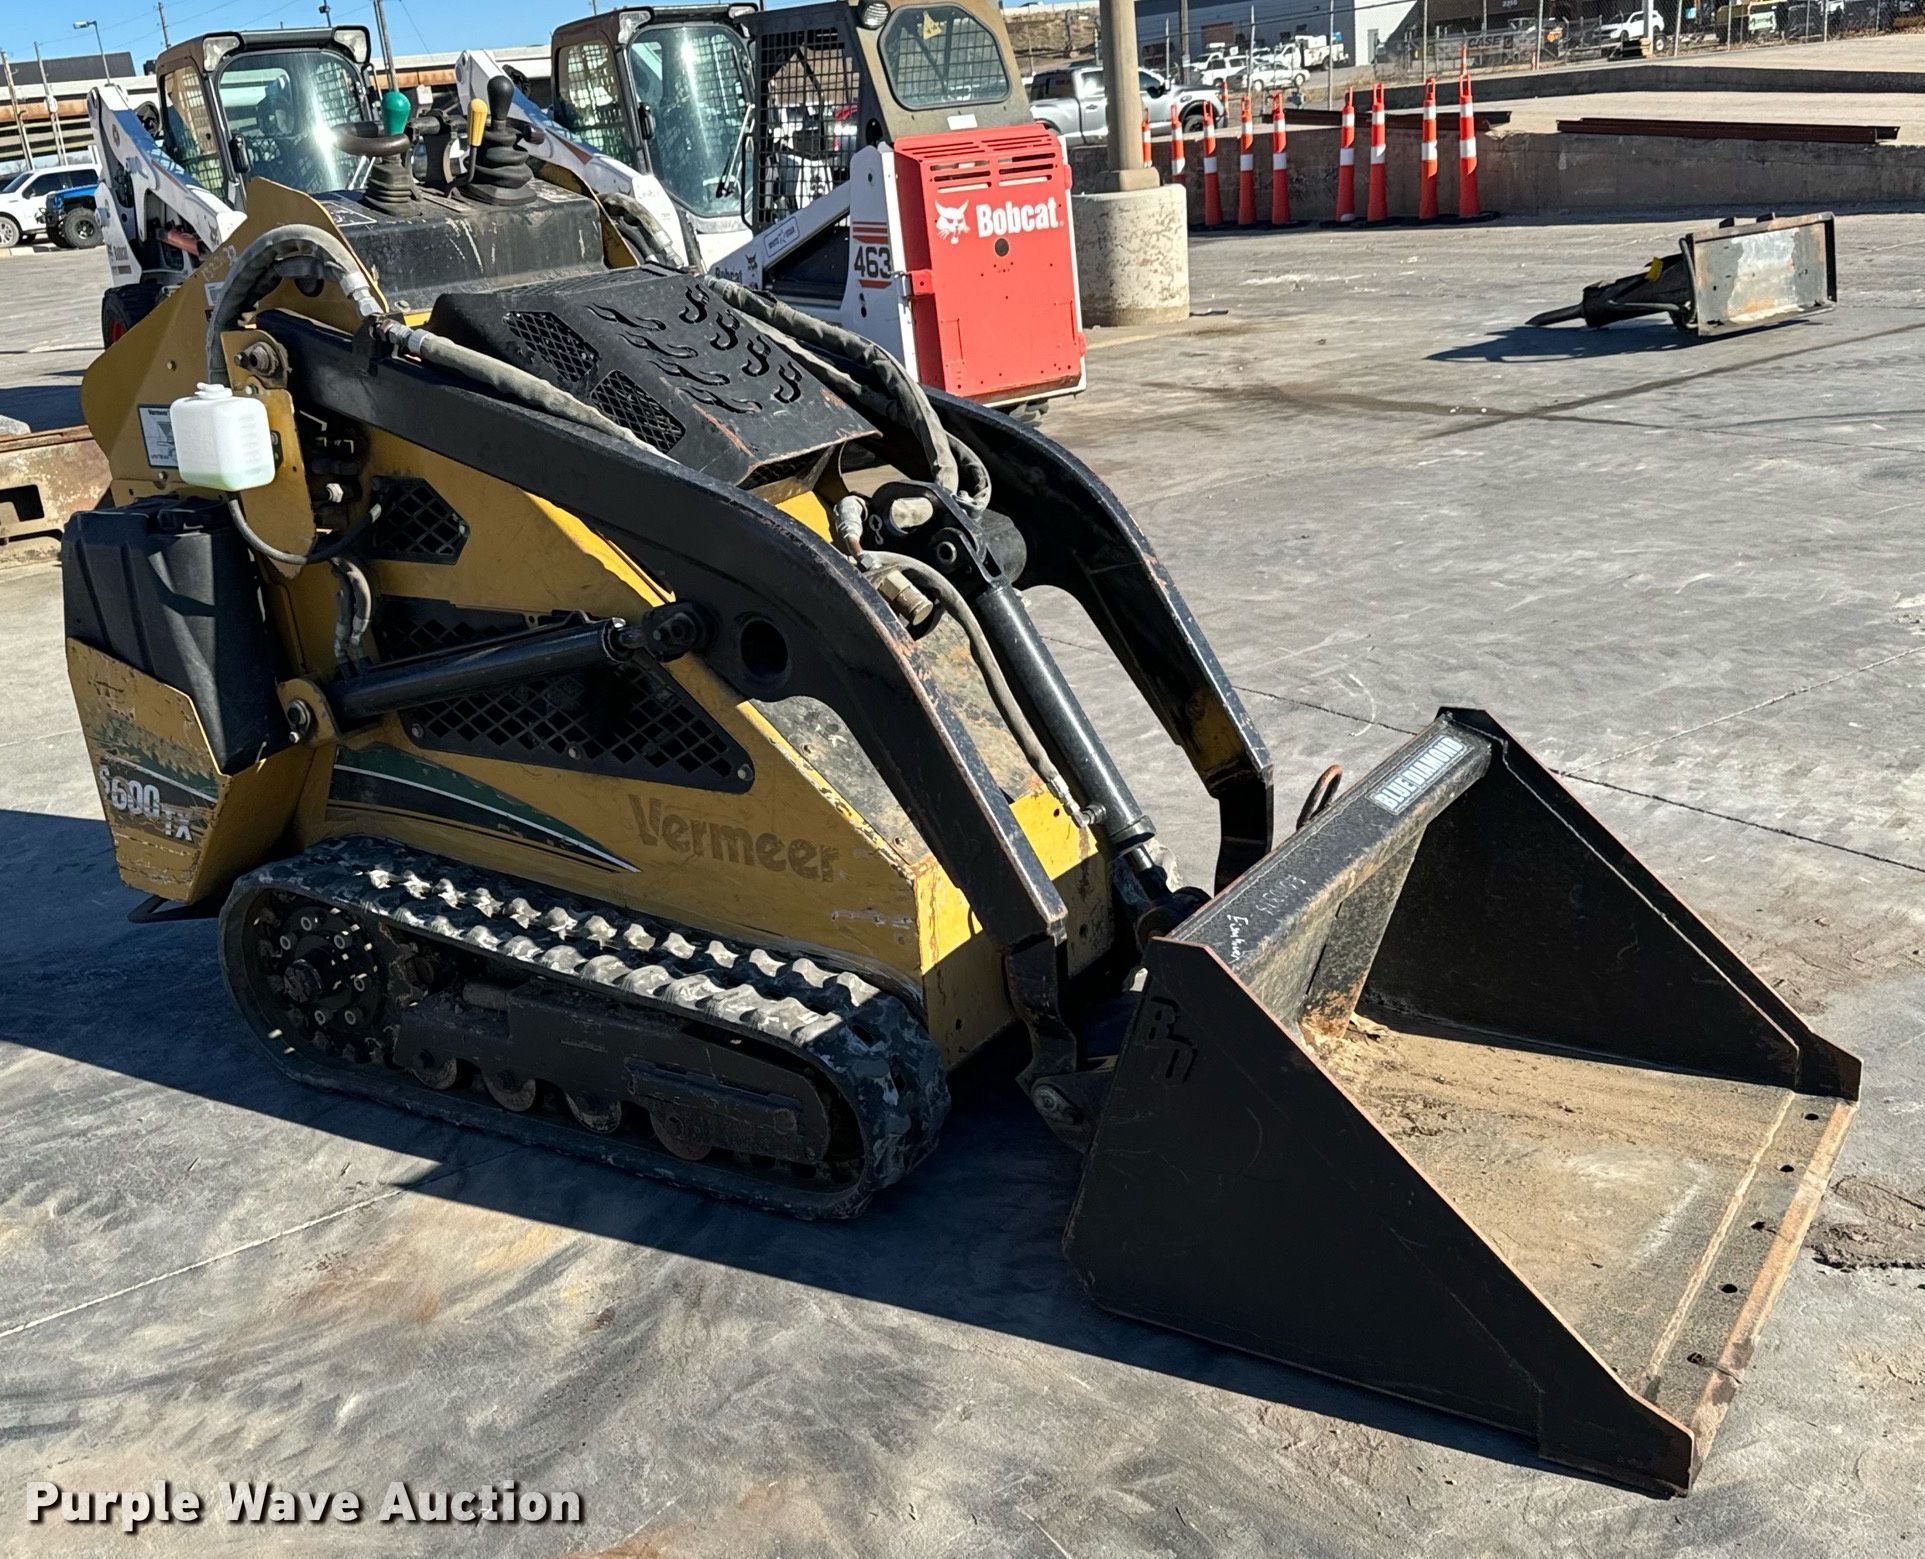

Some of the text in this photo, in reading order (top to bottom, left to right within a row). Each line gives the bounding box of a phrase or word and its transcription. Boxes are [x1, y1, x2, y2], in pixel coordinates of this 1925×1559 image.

[1468, 35, 1500, 48] CASE
[976, 197, 1059, 238] Bobcat
[854, 246, 891, 279] 463
[1373, 736, 1465, 811] BLUE DIAMOND
[628, 794, 839, 882] Vermeer
